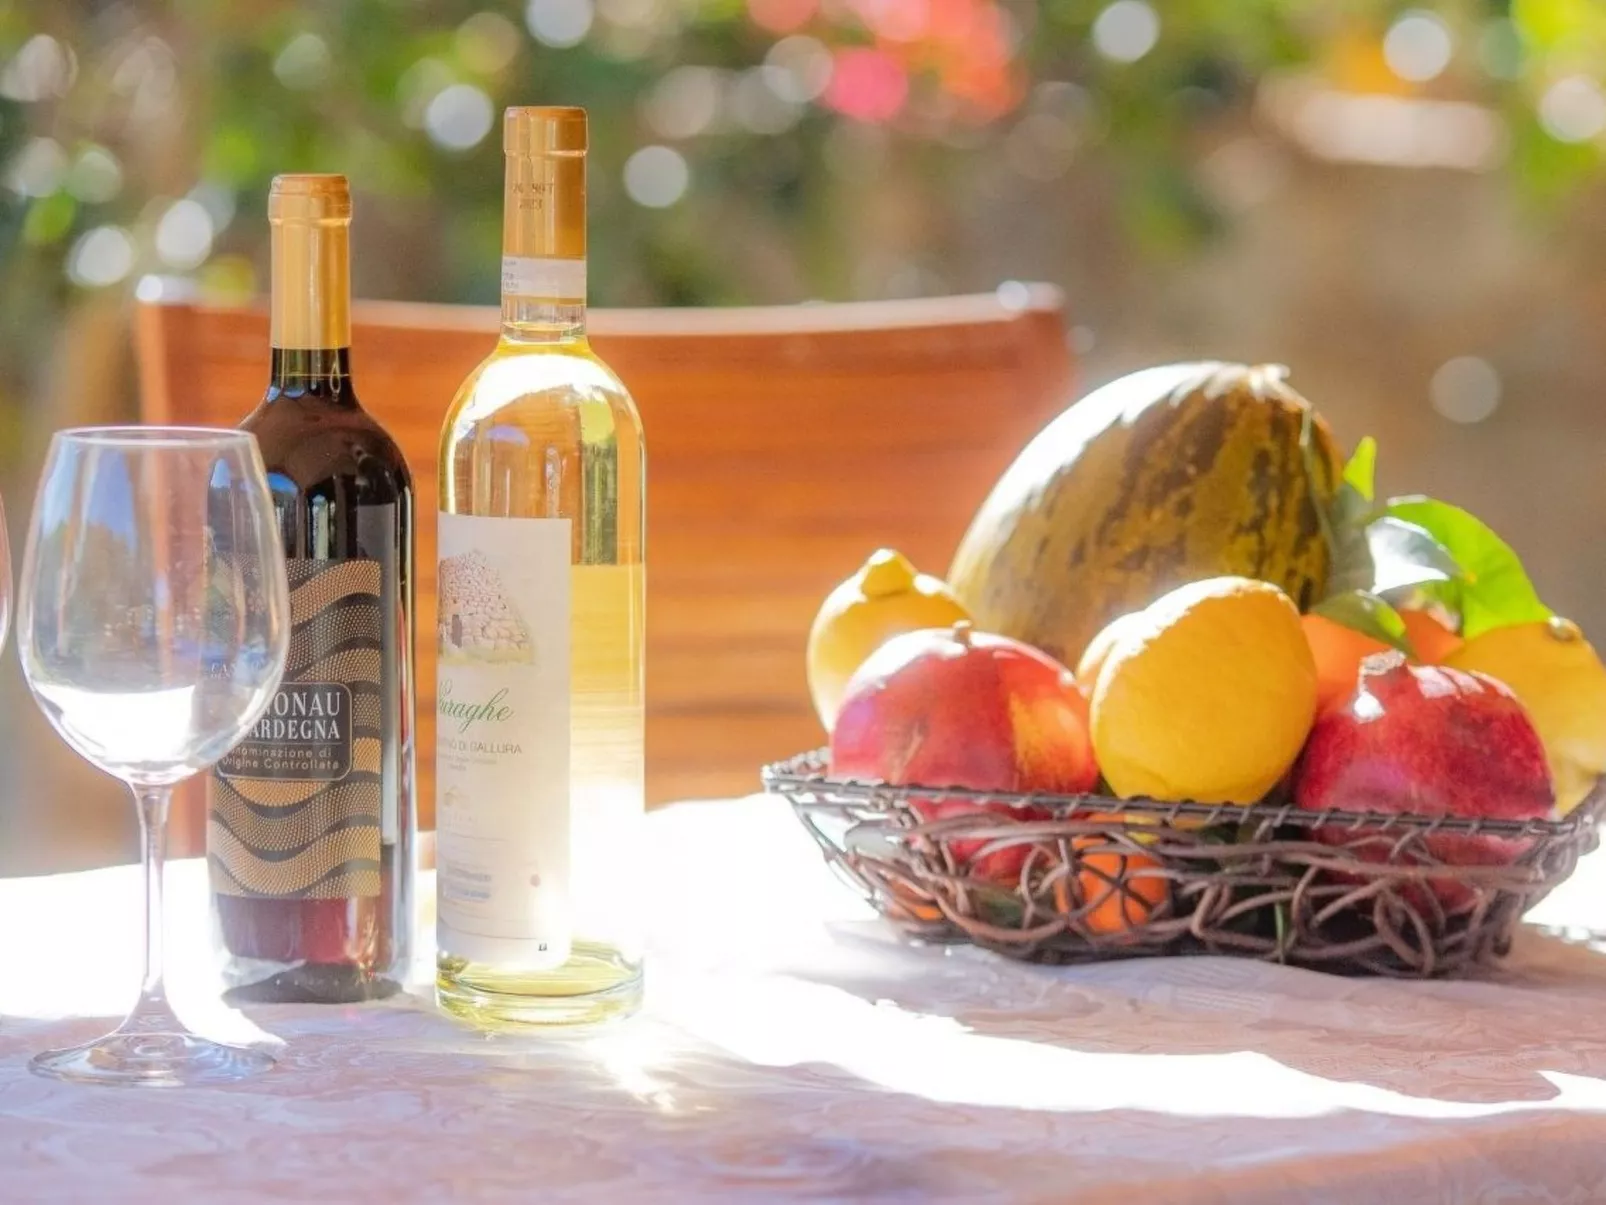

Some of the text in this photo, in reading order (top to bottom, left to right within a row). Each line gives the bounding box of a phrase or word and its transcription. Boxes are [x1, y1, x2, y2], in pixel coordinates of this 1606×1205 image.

[250, 718, 341, 740] ARDEGNA
[231, 746, 332, 758] nominazione di
[470, 741, 523, 755] GALLURA
[263, 757, 340, 771] Controllata
